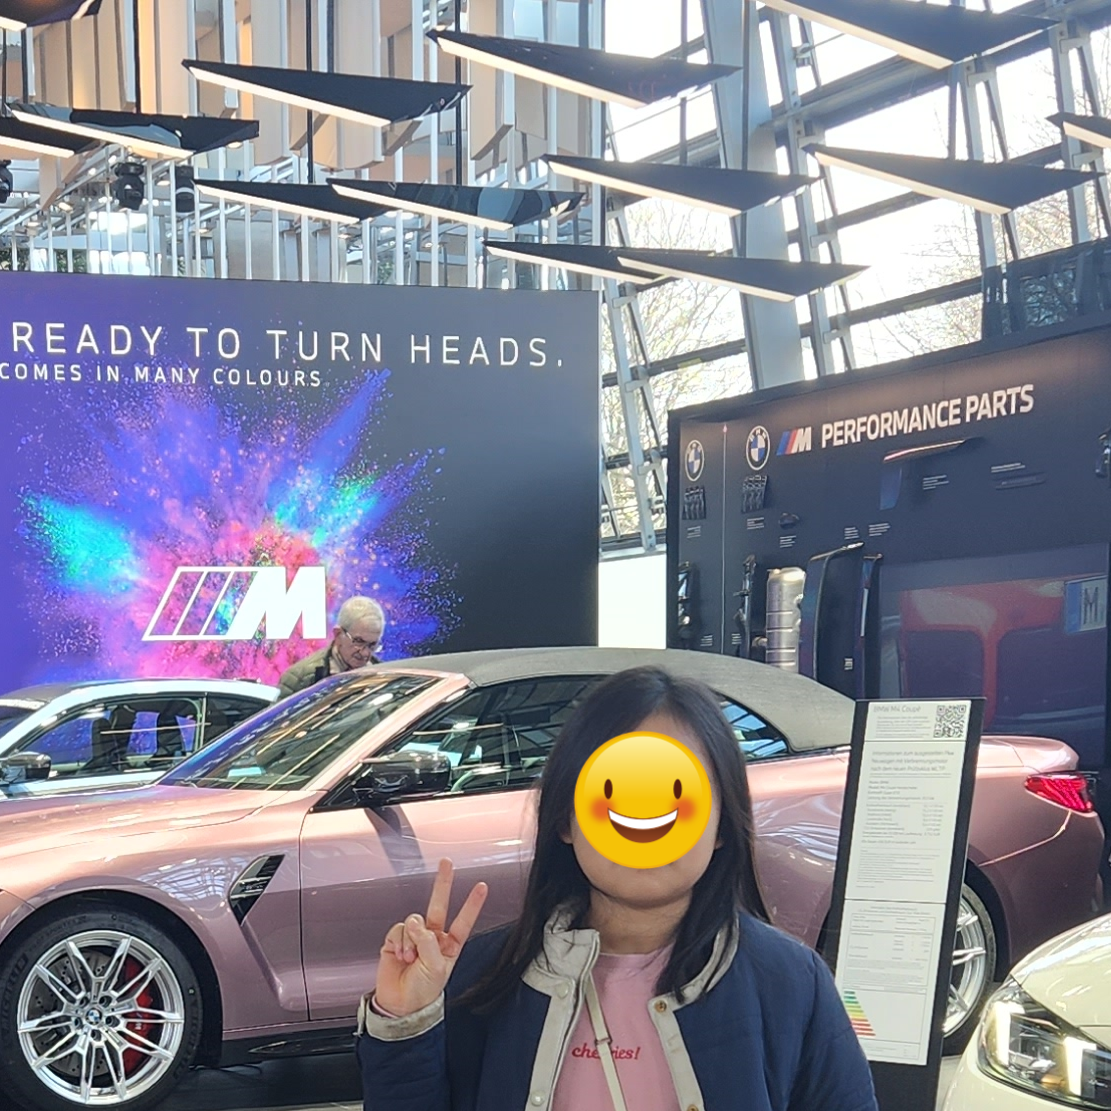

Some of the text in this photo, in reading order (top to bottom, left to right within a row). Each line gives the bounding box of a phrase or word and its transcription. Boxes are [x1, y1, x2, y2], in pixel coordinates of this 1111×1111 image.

[12, 321, 563, 367] READY TO TURN HEADS.
[0, 362, 321, 387] COMES IN MANY COLOURS
[821, 398, 962, 448] PERFORMANCE
[965, 384, 1035, 422] PARTS
[571, 1043, 642, 1060] cheries!
